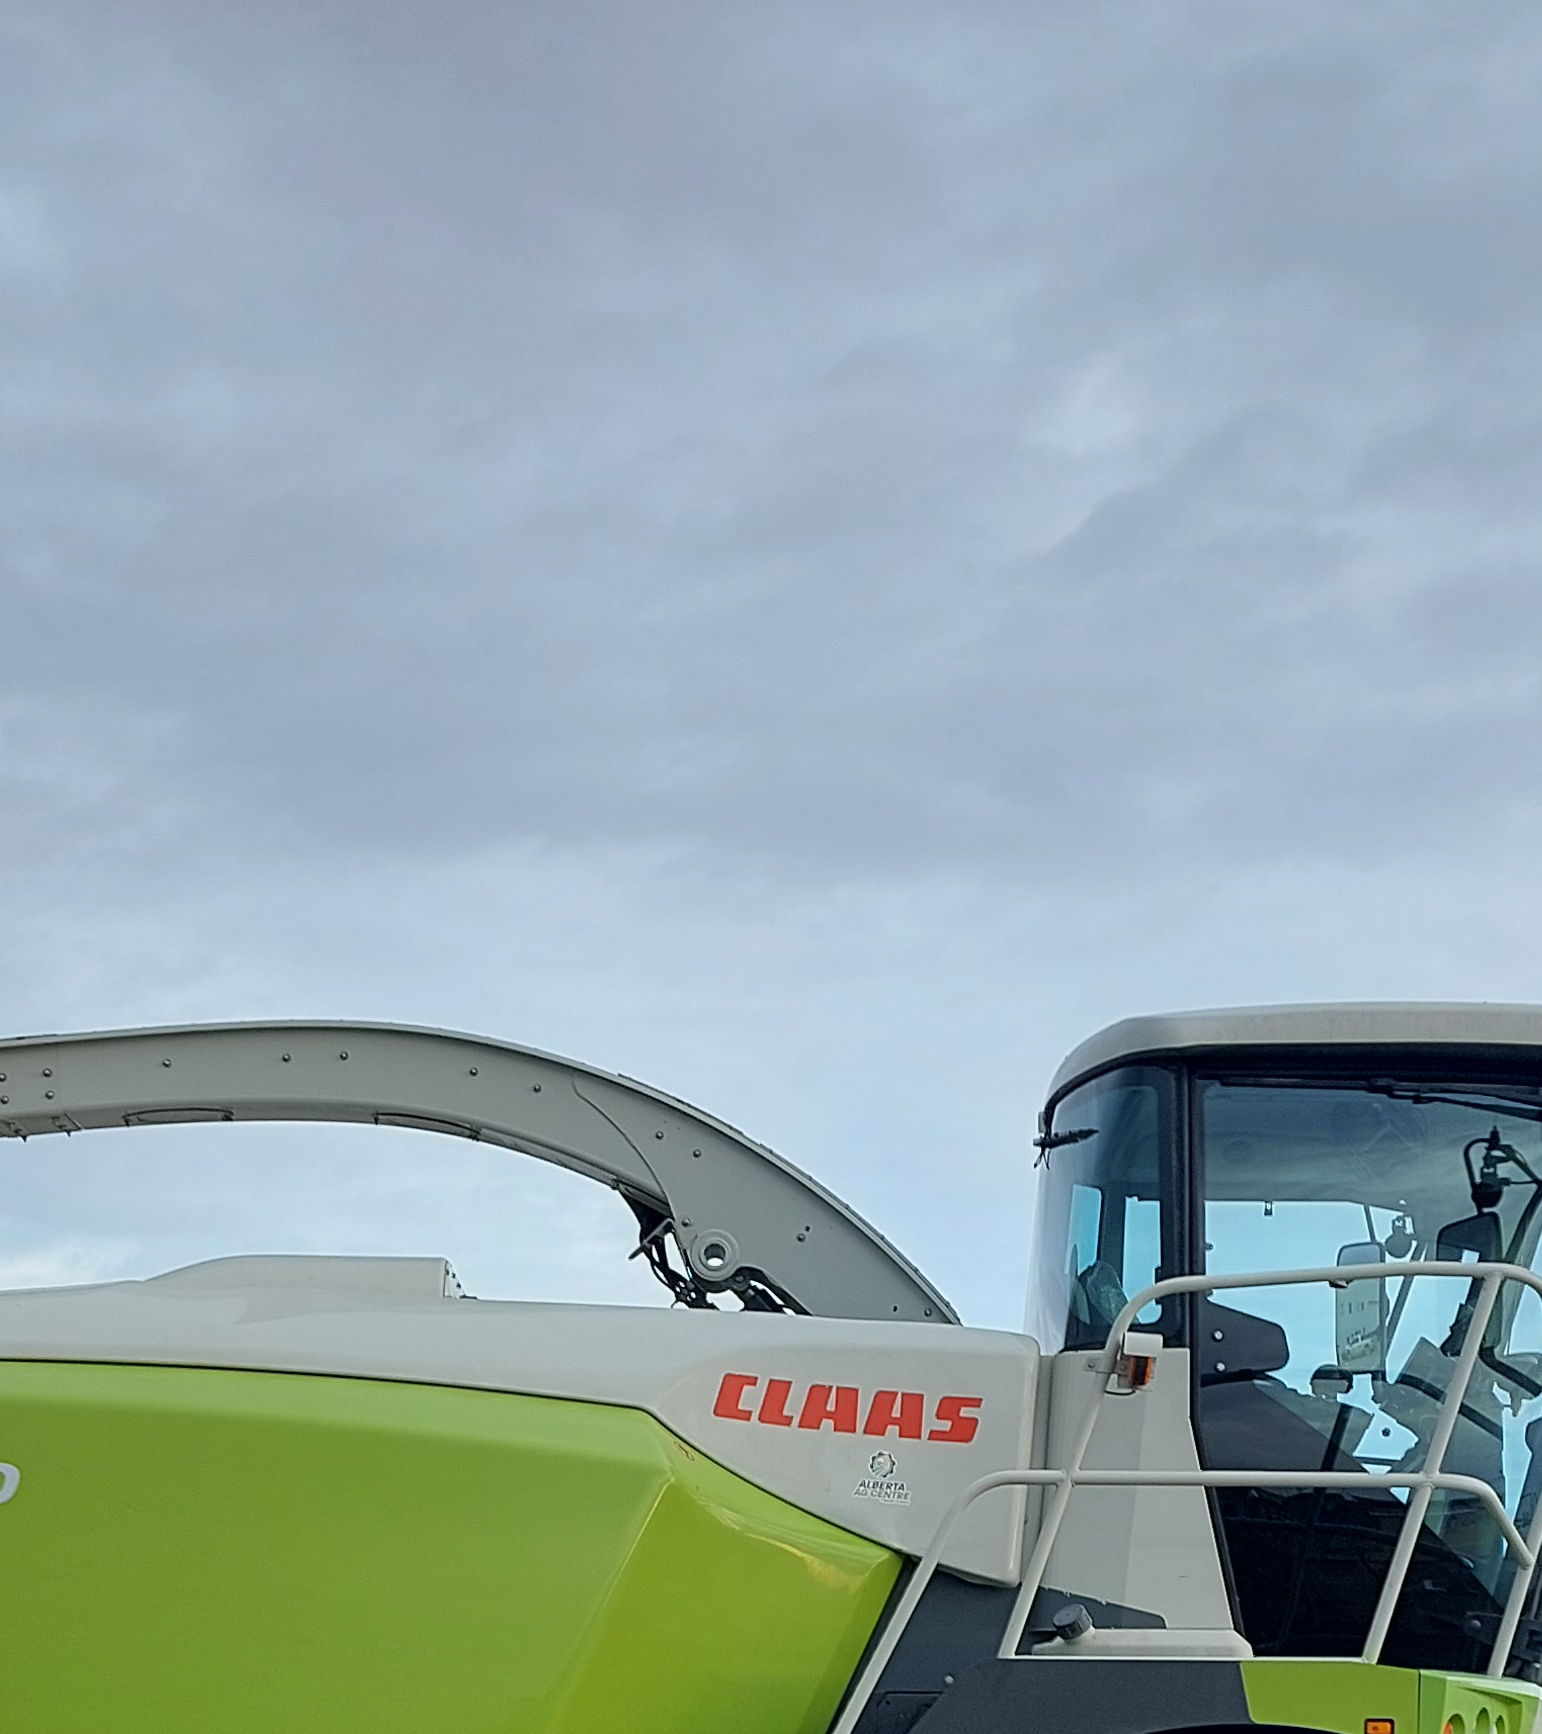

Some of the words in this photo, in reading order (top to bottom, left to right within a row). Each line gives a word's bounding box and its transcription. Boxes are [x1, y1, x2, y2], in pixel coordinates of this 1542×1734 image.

[712, 1372, 983, 1443] CLAAS
[858, 1479, 905, 1491] ALBERTA
[870, 1490, 910, 1500] CENTRE
